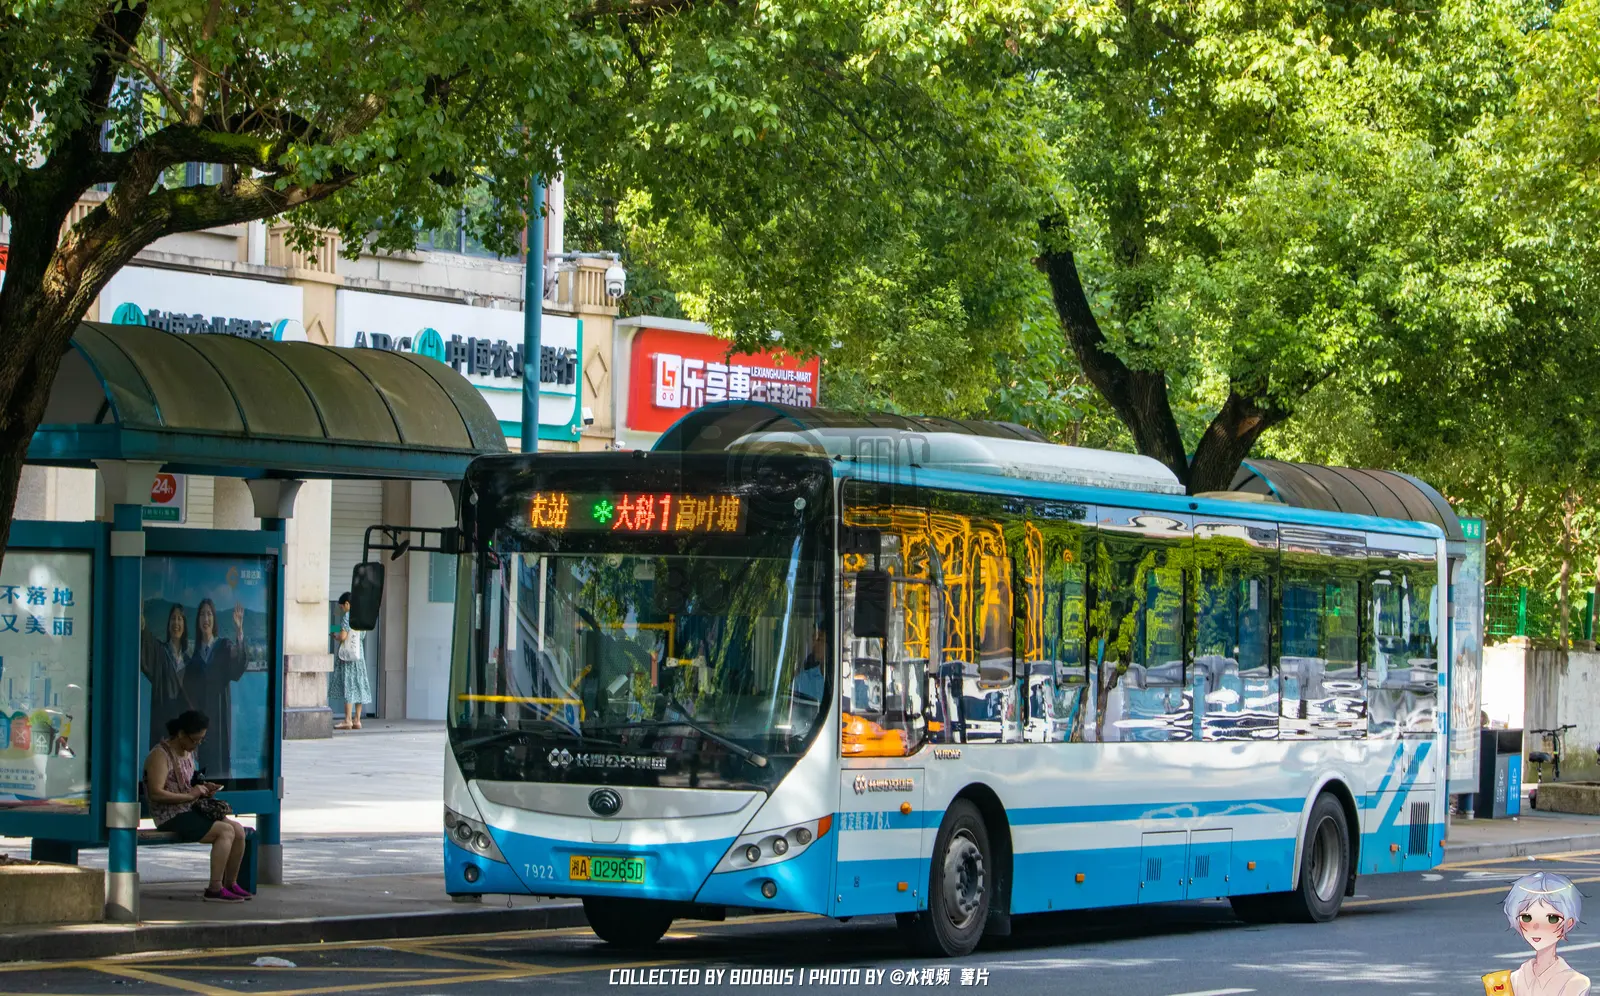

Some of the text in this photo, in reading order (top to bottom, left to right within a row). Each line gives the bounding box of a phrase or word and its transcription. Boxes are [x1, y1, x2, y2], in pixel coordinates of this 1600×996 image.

[675, 495, 740, 532] 高叶塘
[0, 585, 75, 607] 不落地
[0, 614, 74, 636] 又美丽
[523, 863, 554, 880] 7922
